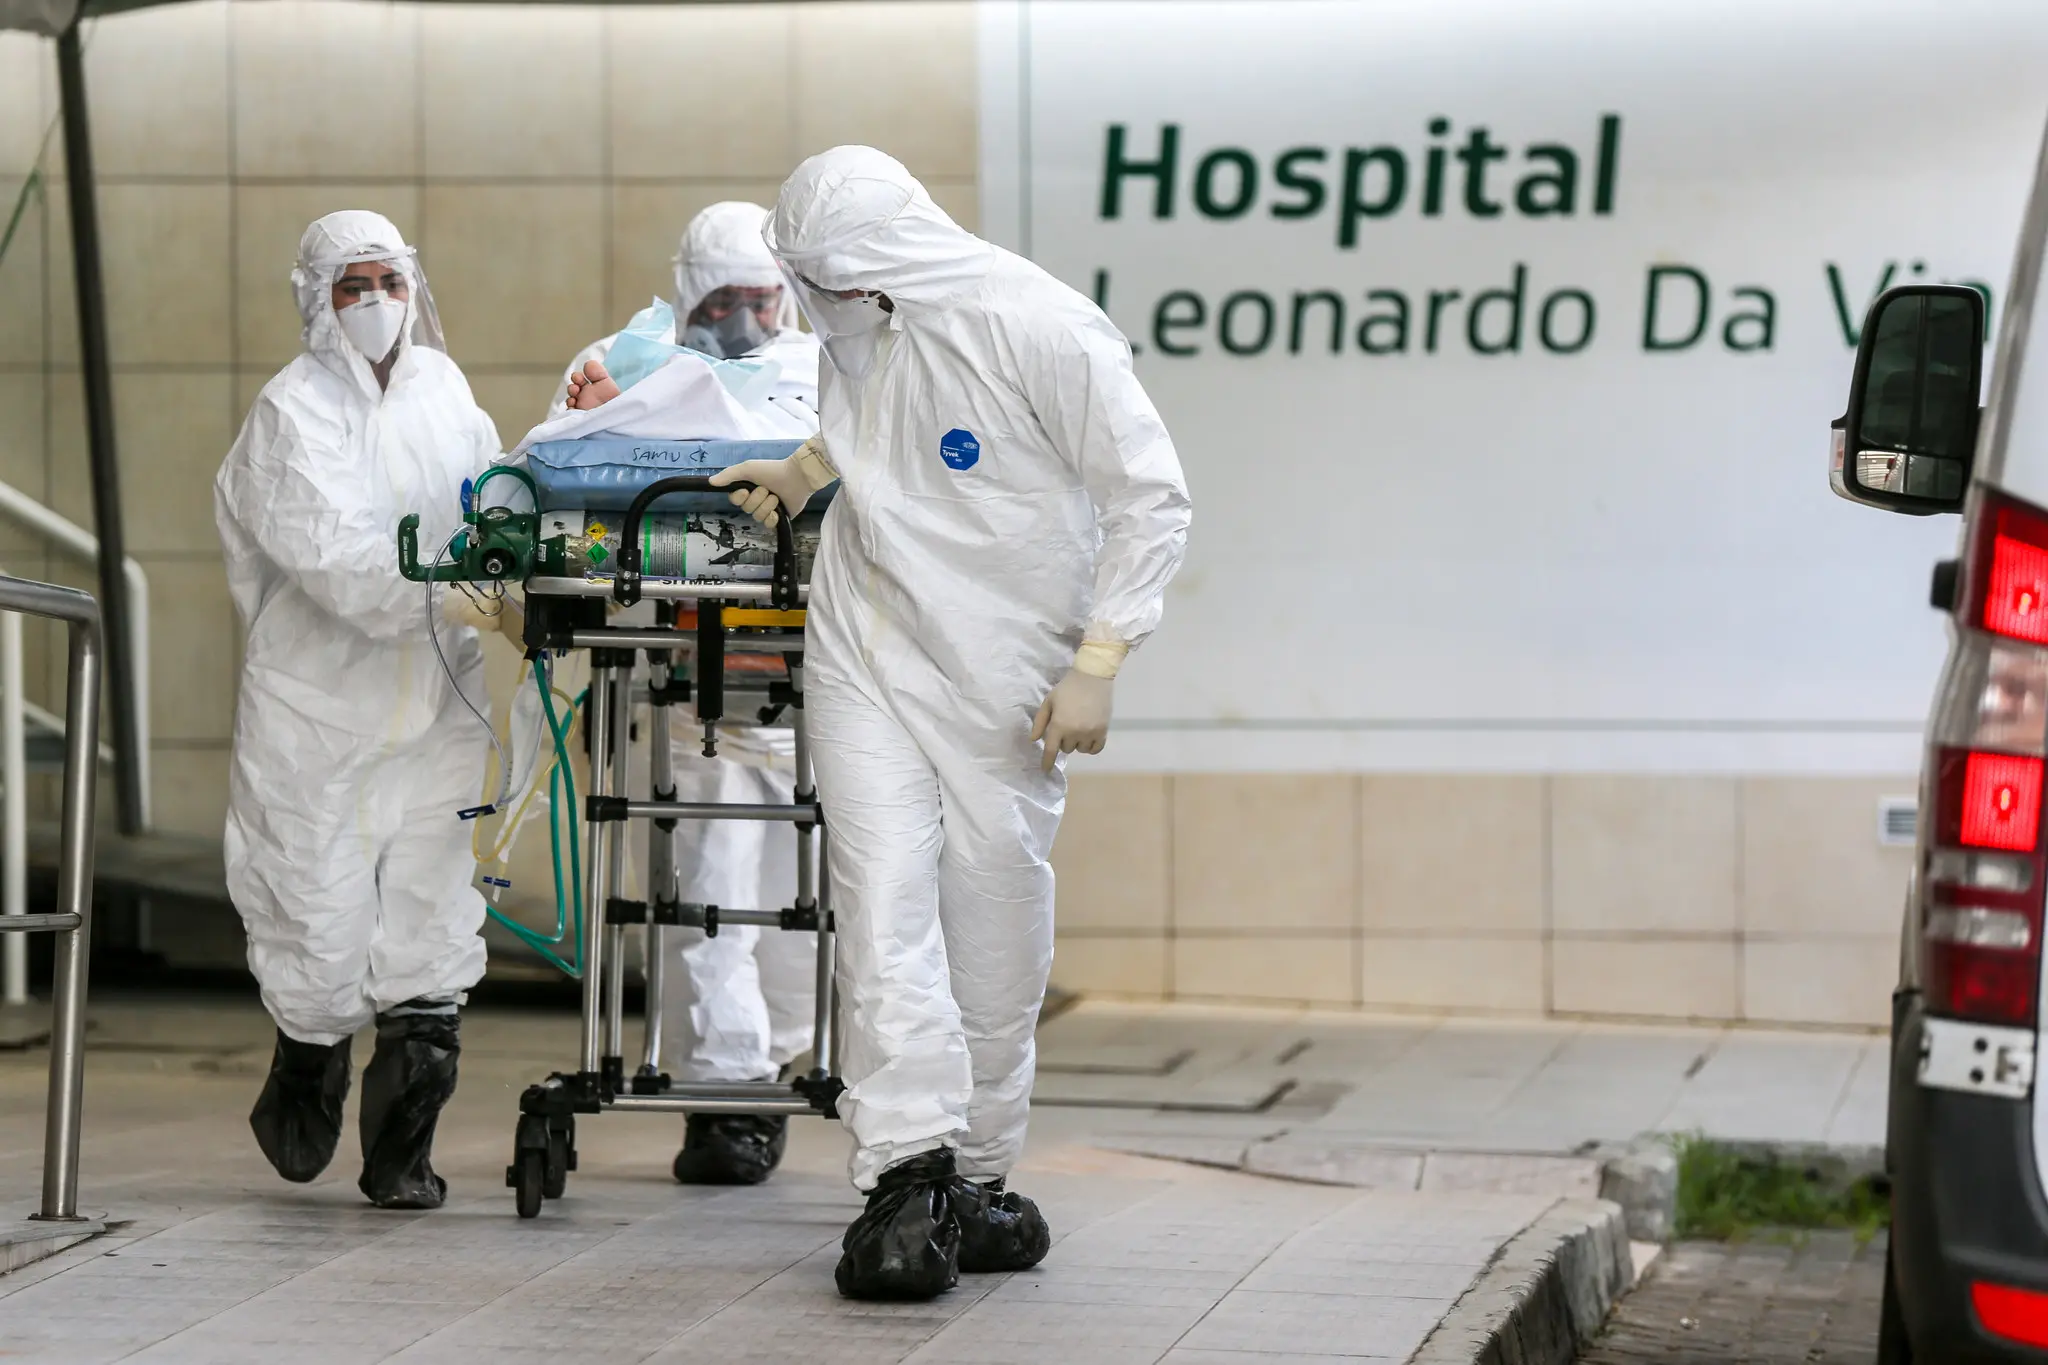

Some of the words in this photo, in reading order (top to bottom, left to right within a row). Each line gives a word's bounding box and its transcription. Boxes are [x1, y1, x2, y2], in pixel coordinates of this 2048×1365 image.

[1100, 114, 1622, 249] Hospital
[1643, 265, 1776, 351] Da
[632, 447, 681, 463] SAMU
[942, 449, 959, 457] Tyvek
